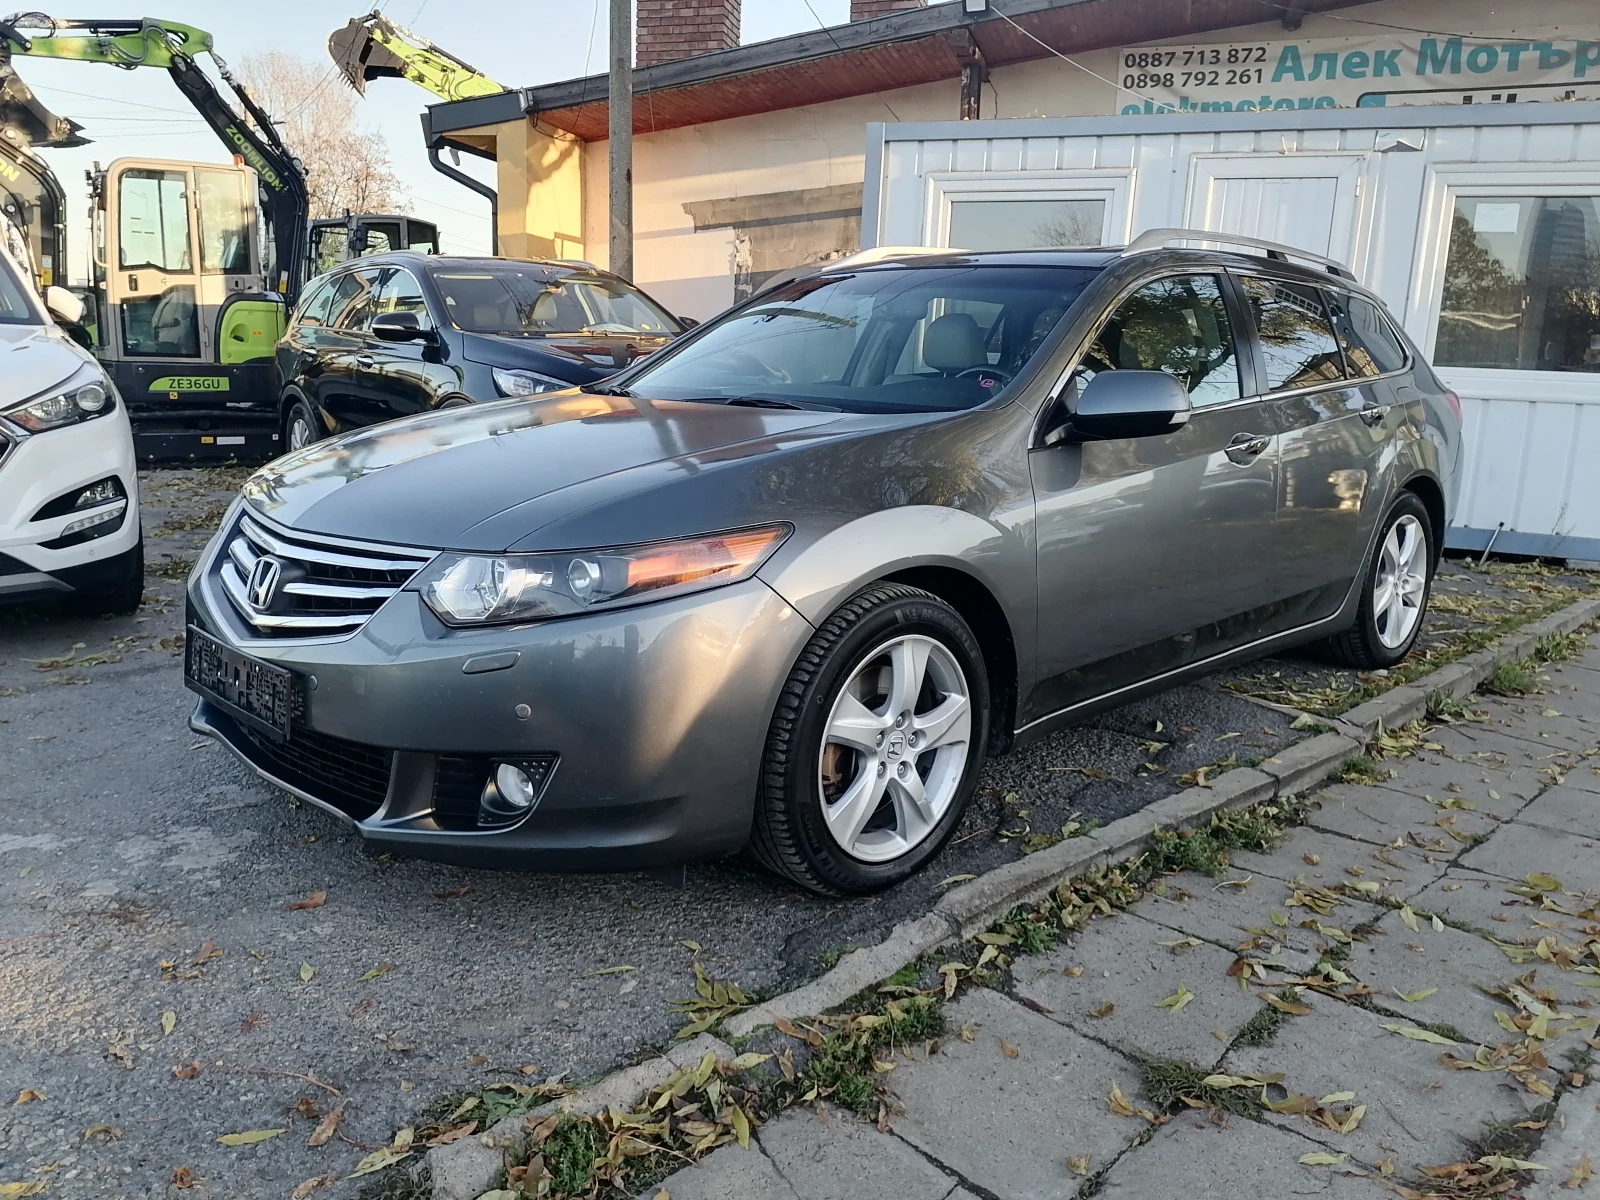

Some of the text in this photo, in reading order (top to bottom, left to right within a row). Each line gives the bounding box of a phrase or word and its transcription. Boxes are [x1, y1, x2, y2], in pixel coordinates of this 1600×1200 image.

[1124, 46, 1267, 69] 0887 713 872
[1271, 36, 1600, 83] Алек Мотър
[1123, 68, 1263, 90] 0898 792 261
[225, 124, 283, 191] ZOOMLION
[168, 378, 220, 389] ZE36GU
